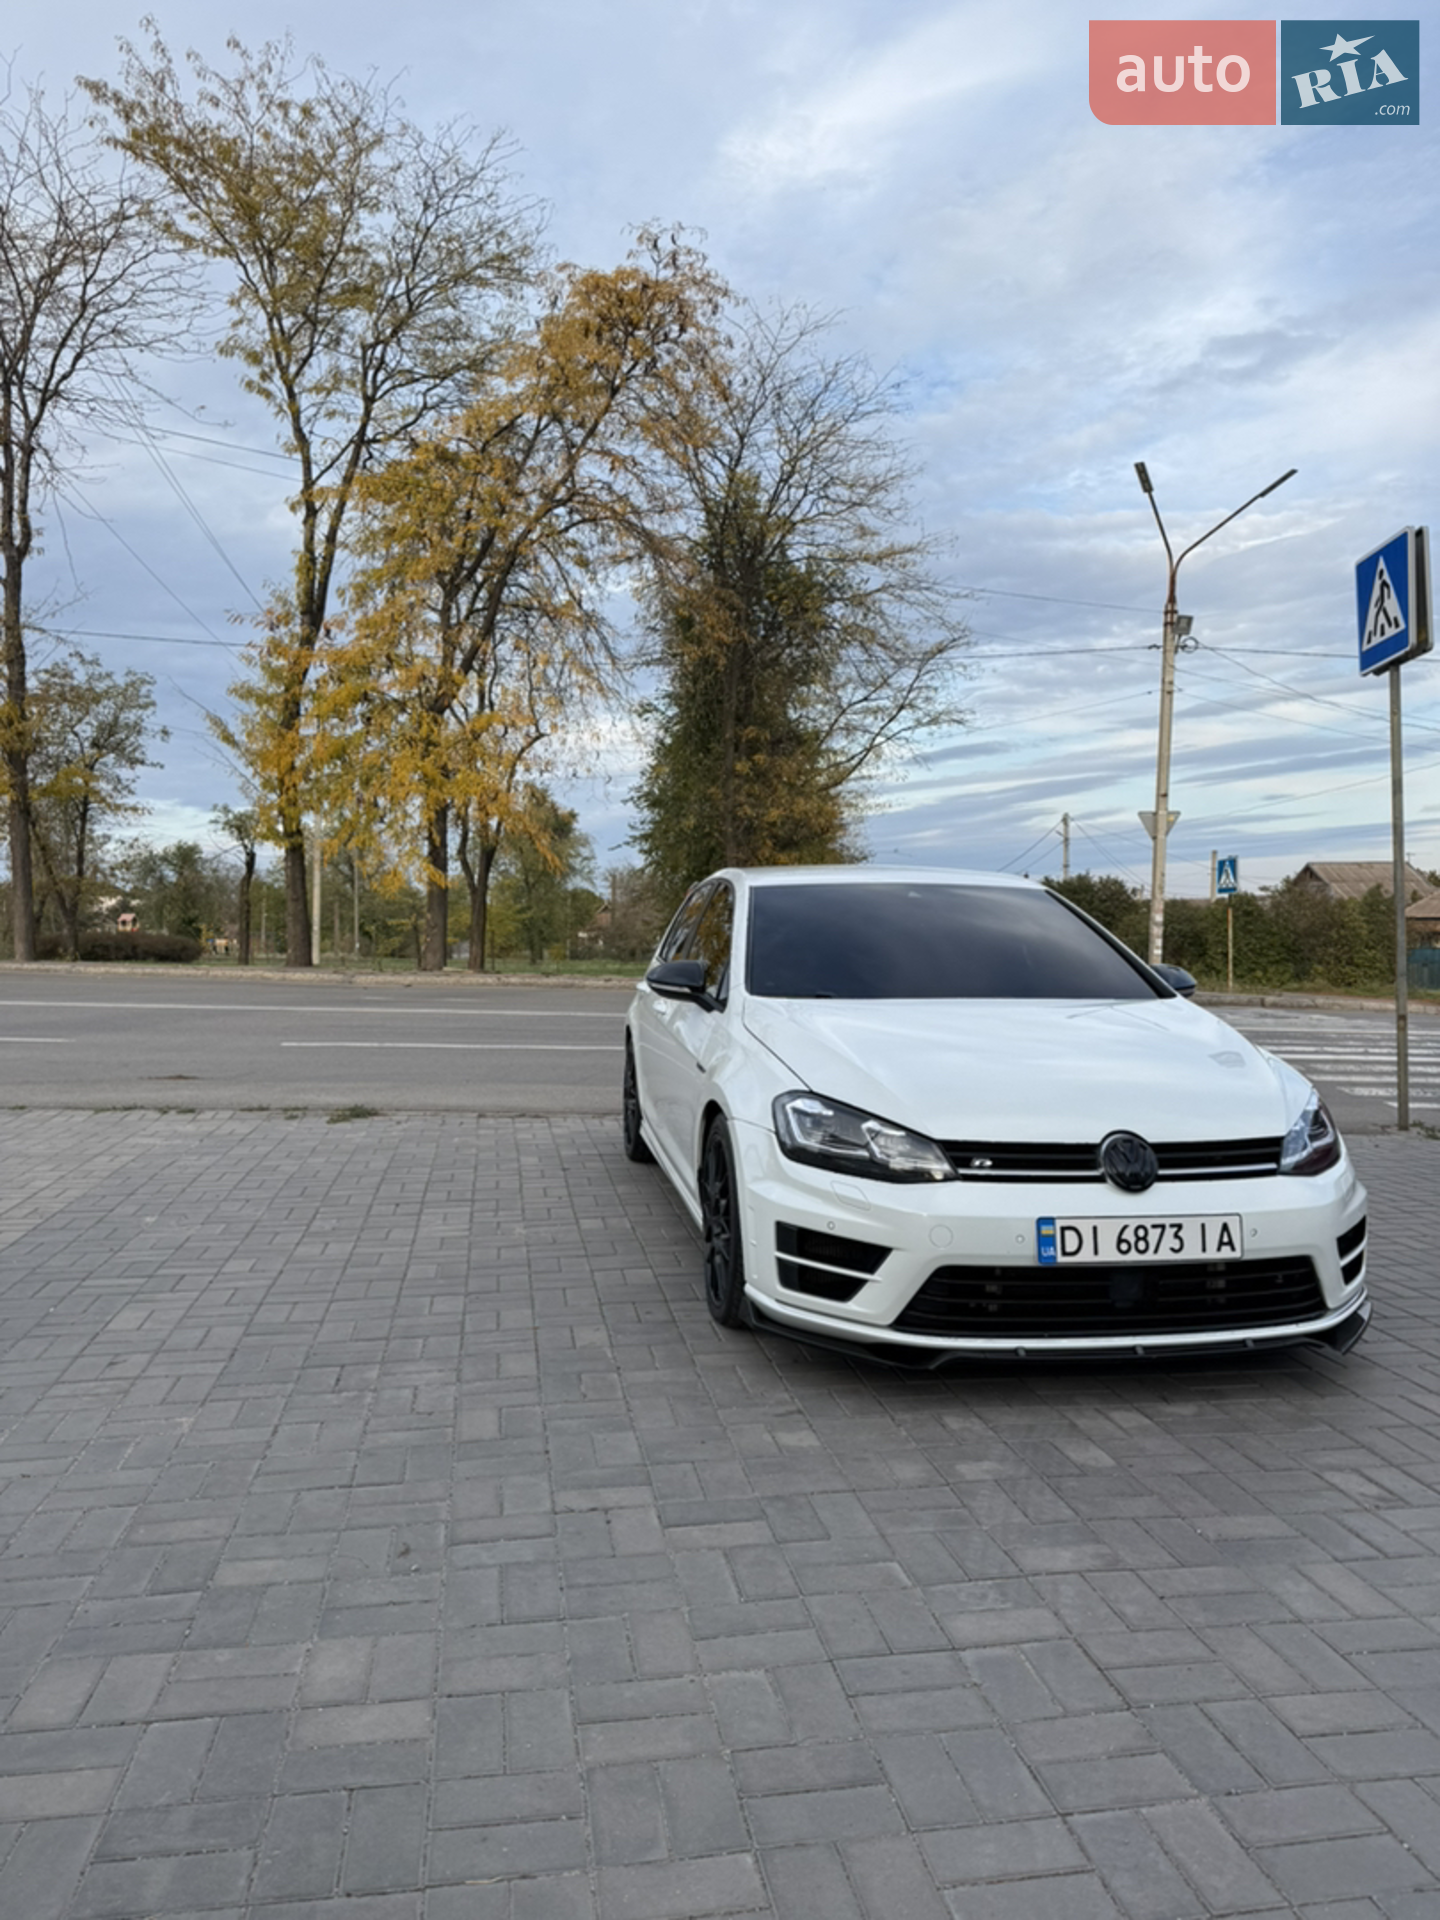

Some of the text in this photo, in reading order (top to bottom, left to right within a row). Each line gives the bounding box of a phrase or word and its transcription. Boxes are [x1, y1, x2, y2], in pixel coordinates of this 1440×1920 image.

[1059, 1221, 1236, 1257] DI 6873 IA
